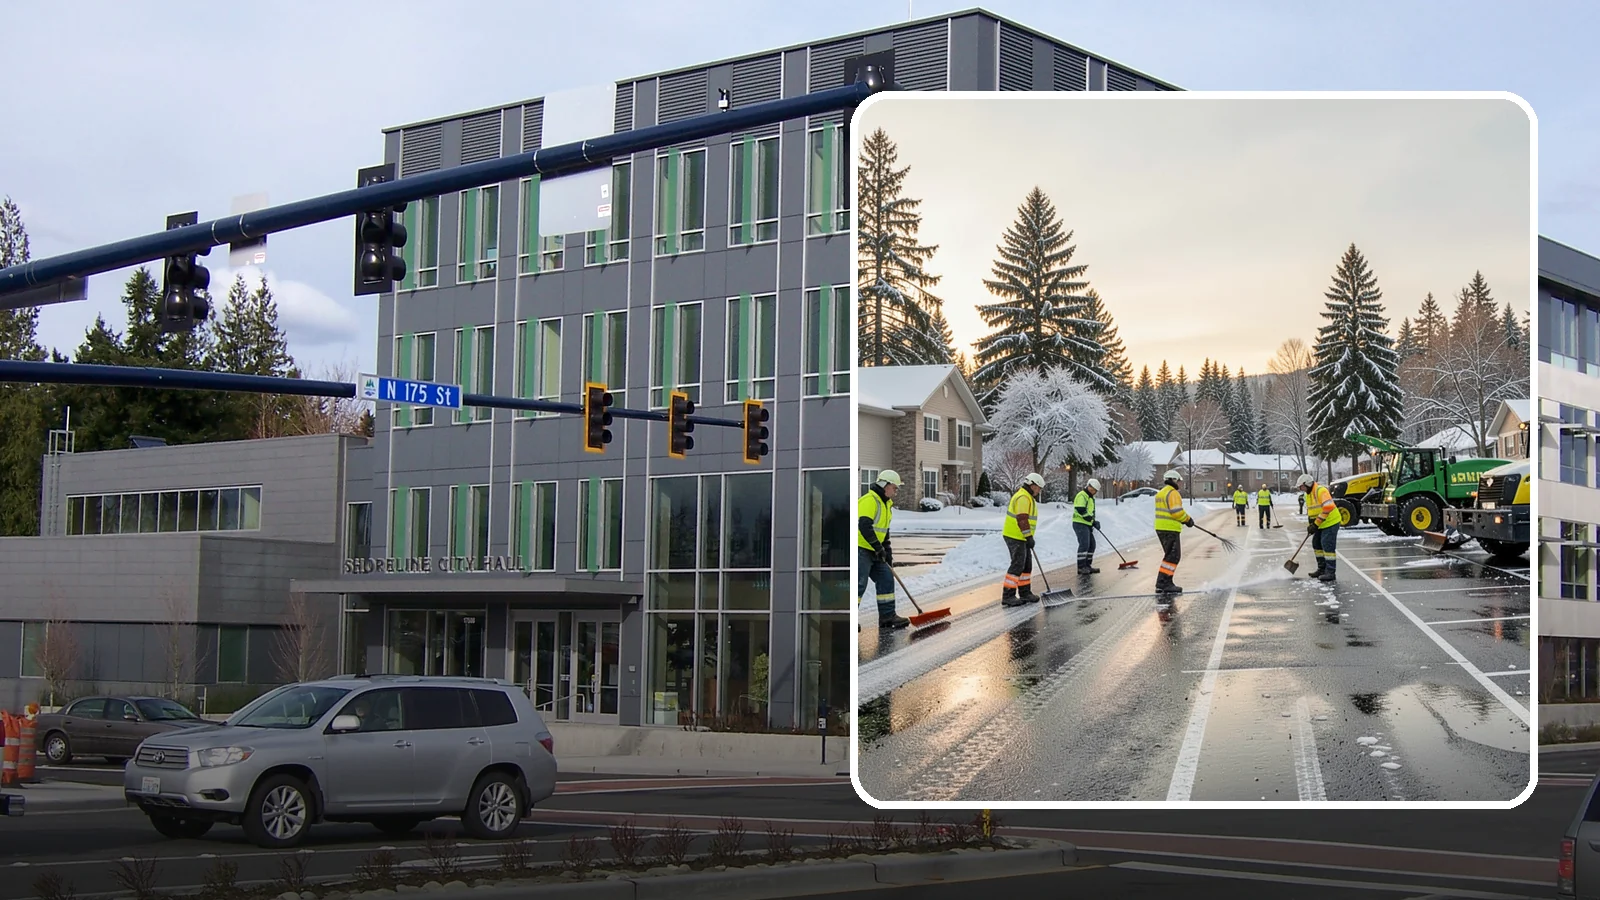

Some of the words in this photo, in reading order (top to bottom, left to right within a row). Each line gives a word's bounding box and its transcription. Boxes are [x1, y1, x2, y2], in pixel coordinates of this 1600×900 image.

[387, 380, 396, 400] N
[405, 382, 427, 403] 175
[436, 386, 451, 406] St
[344, 556, 432, 574] SHORELINE
[438, 556, 476, 572] CITY
[483, 555, 526, 572] HALL
